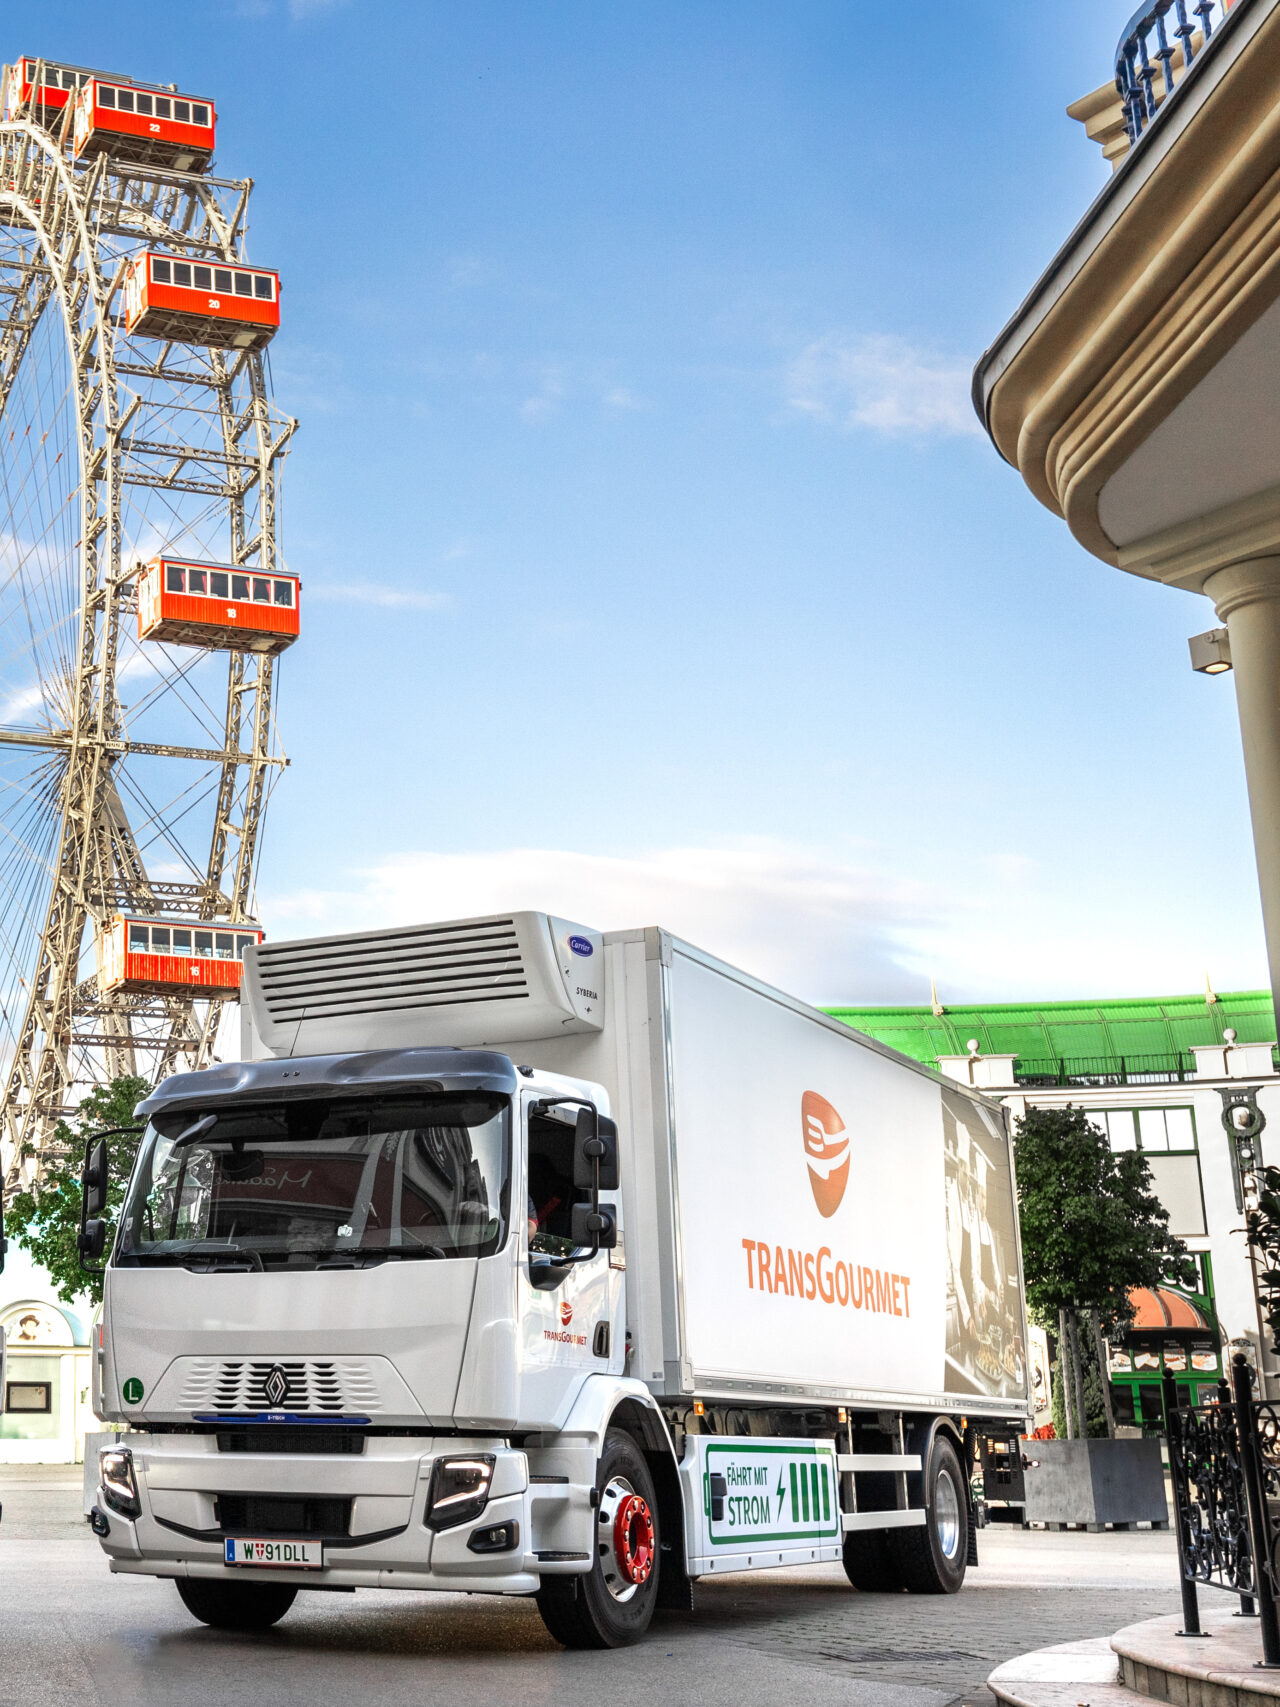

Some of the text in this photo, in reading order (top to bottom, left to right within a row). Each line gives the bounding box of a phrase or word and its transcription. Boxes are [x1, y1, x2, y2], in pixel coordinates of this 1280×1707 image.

[149, 123, 160, 133] 22
[208, 299, 220, 309] 20
[227, 608, 237, 619] 18
[571, 940, 591, 953] Carrier
[190, 966, 200, 976] 16
[576, 987, 598, 1000] SYBERIA
[742, 1238, 911, 1318] TRANSGOURMET
[129, 1381, 139, 1400] L
[727, 1462, 768, 1486] FÄHRT MIT
[728, 1496, 771, 1526] STROM
